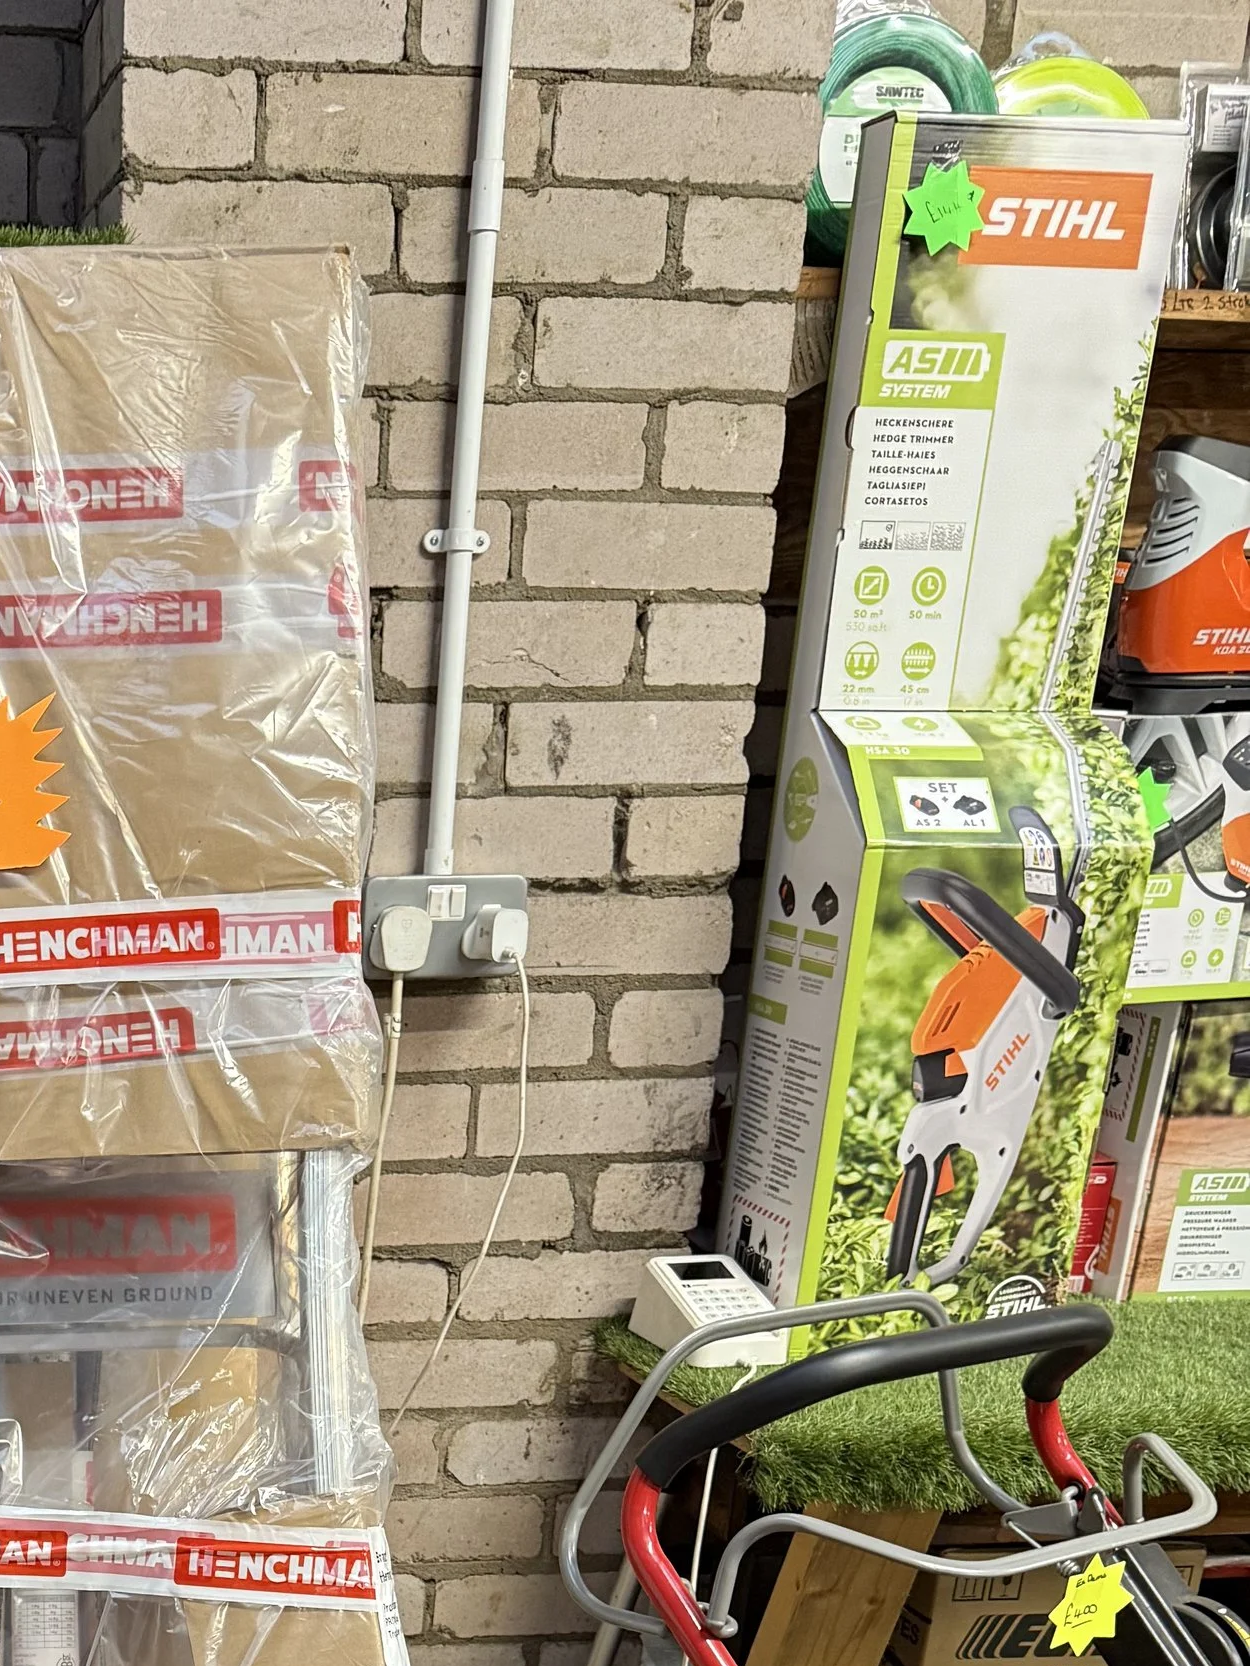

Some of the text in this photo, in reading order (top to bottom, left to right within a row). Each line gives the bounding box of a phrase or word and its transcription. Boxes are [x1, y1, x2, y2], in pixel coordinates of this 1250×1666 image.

[876, 85, 924, 98] SAWTEC
[981, 197, 1125, 240] STIHL
[879, 382, 951, 398] SYSTEM
[875, 418, 954, 428] HECKENSCHERE
[873, 434, 954, 444] HEDGE TRIMMER
[871, 450, 936, 459] TAILLE-HAIES
[868, 466, 950, 475] HEGGENSCHAAR
[867, 481, 926, 491] TAGLIASIEPI
[864, 496, 928, 506] CORTASETOS
[853, 609, 867, 619] 50
[909, 610, 942, 620] 50 min
[842, 685, 856, 693] 22
[900, 685, 930, 694] 45 cm
[865, 746, 910, 756] HSA 30
[928, 782, 958, 793] SET
[916, 819, 941, 827] AS 2
[963, 819, 977, 827] AL
[985, 1033, 1030, 1092] STIHL
[28, 1287, 113, 1305] UNEVEN
[123, 1285, 213, 1303] GROUND
[984, 1295, 1046, 1320] STIHL
[1064, 1603, 1098, 1627] £400
